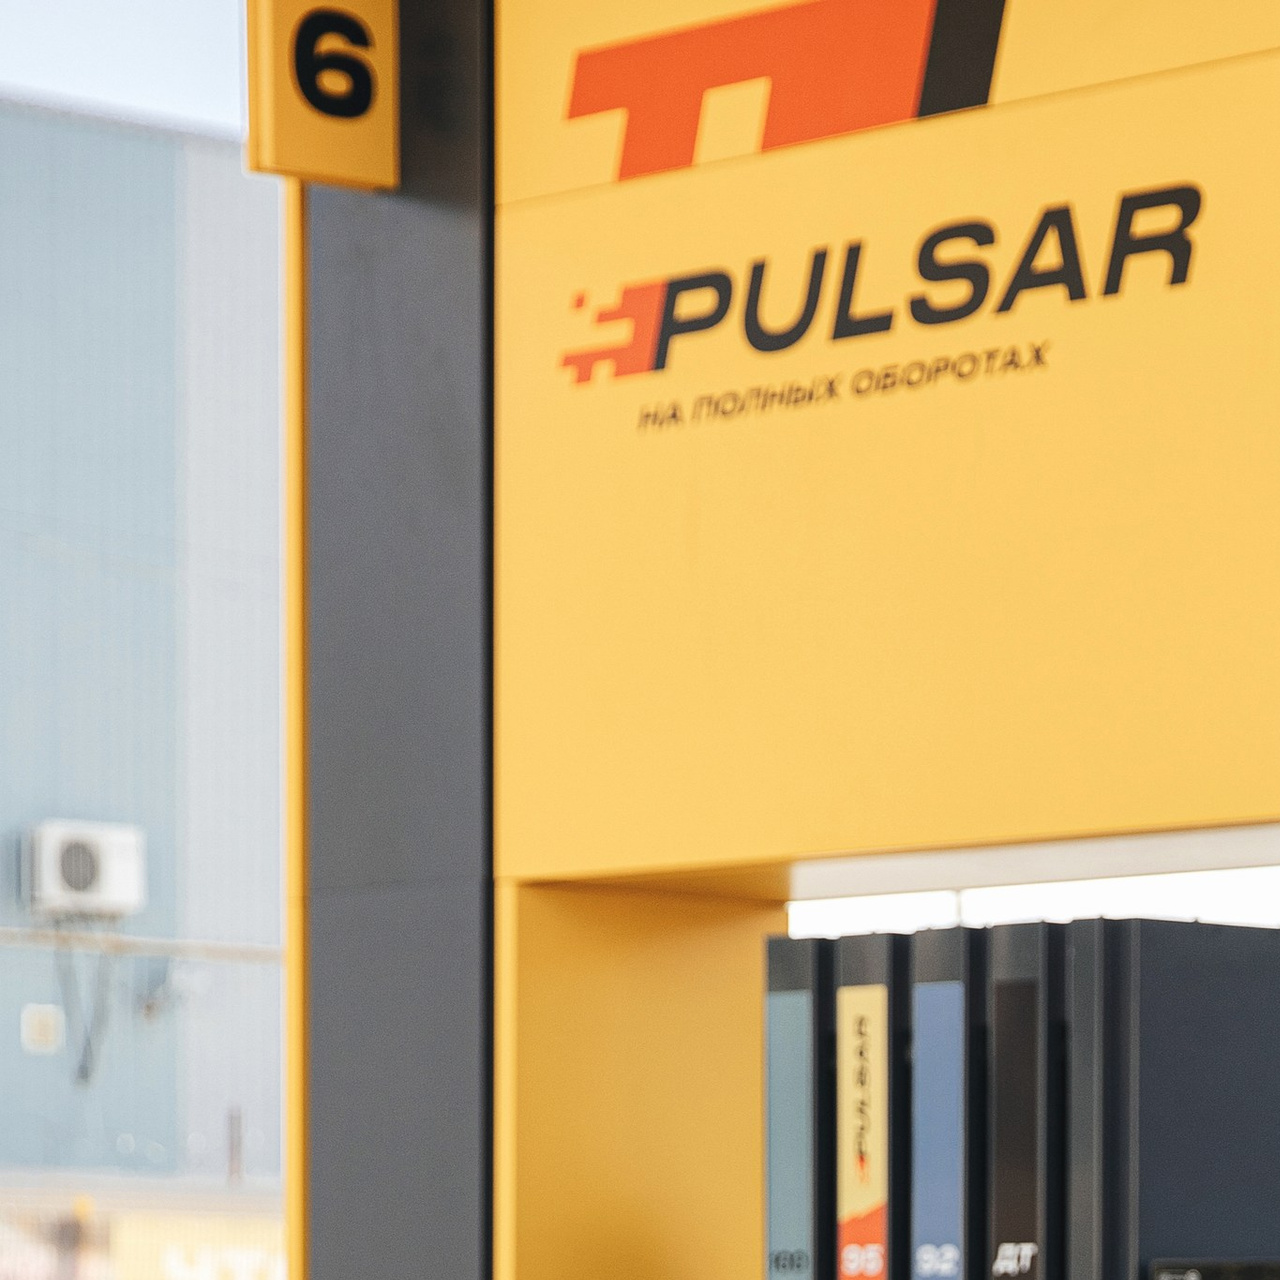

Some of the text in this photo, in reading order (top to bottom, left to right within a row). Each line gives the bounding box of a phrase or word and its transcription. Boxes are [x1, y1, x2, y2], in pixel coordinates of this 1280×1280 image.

[293, 8, 375, 119] 6
[651, 183, 1204, 372] PULSAR
[638, 339, 1051, 432] НА ПОЛНЫХ ОБОРОТАХ
[840, 1242, 886, 1278] 95
[915, 1242, 961, 1278] 92
[993, 1242, 1038, 1278] ДТ
